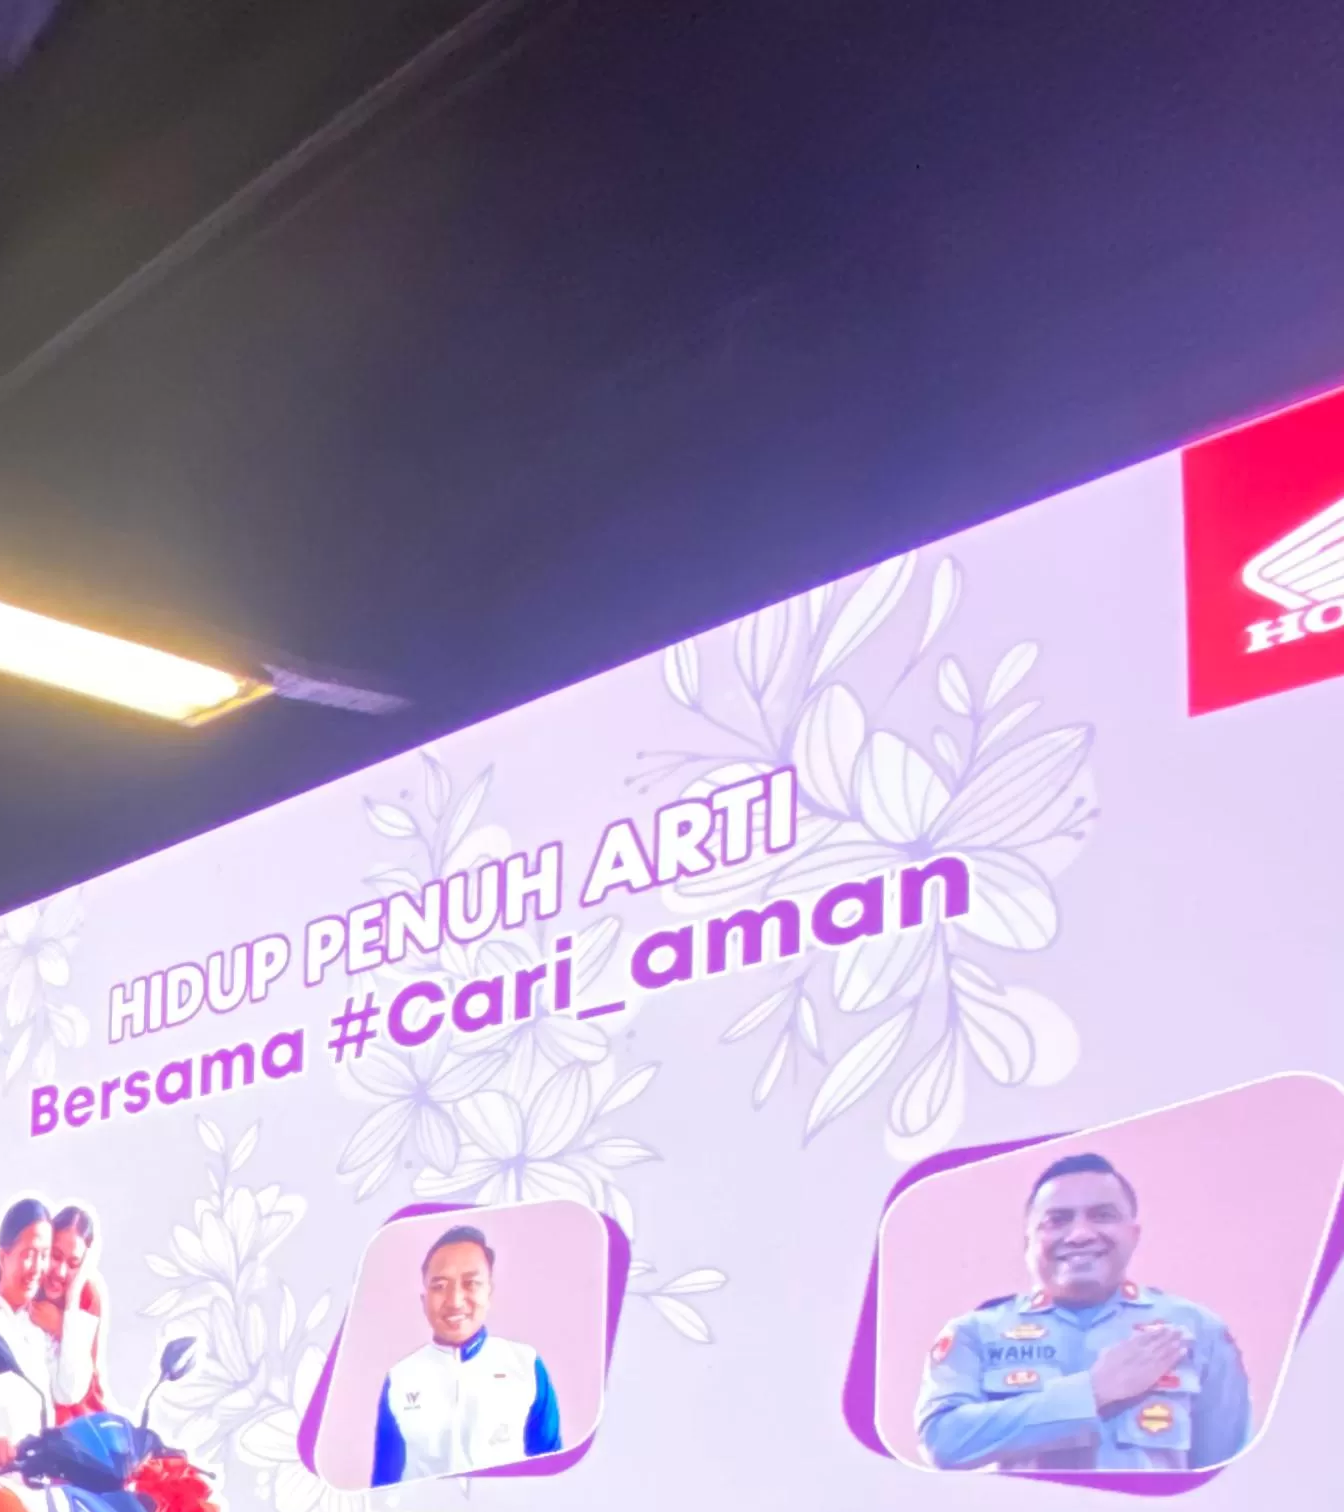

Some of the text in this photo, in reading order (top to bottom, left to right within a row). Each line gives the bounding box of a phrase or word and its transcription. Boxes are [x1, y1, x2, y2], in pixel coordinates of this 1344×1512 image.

[28, 854, 972, 1137] Bersama #Cari_aman
[106, 765, 800, 1045] HIDUP PENUH ARTI
[987, 1344, 1057, 1363] WAHID
